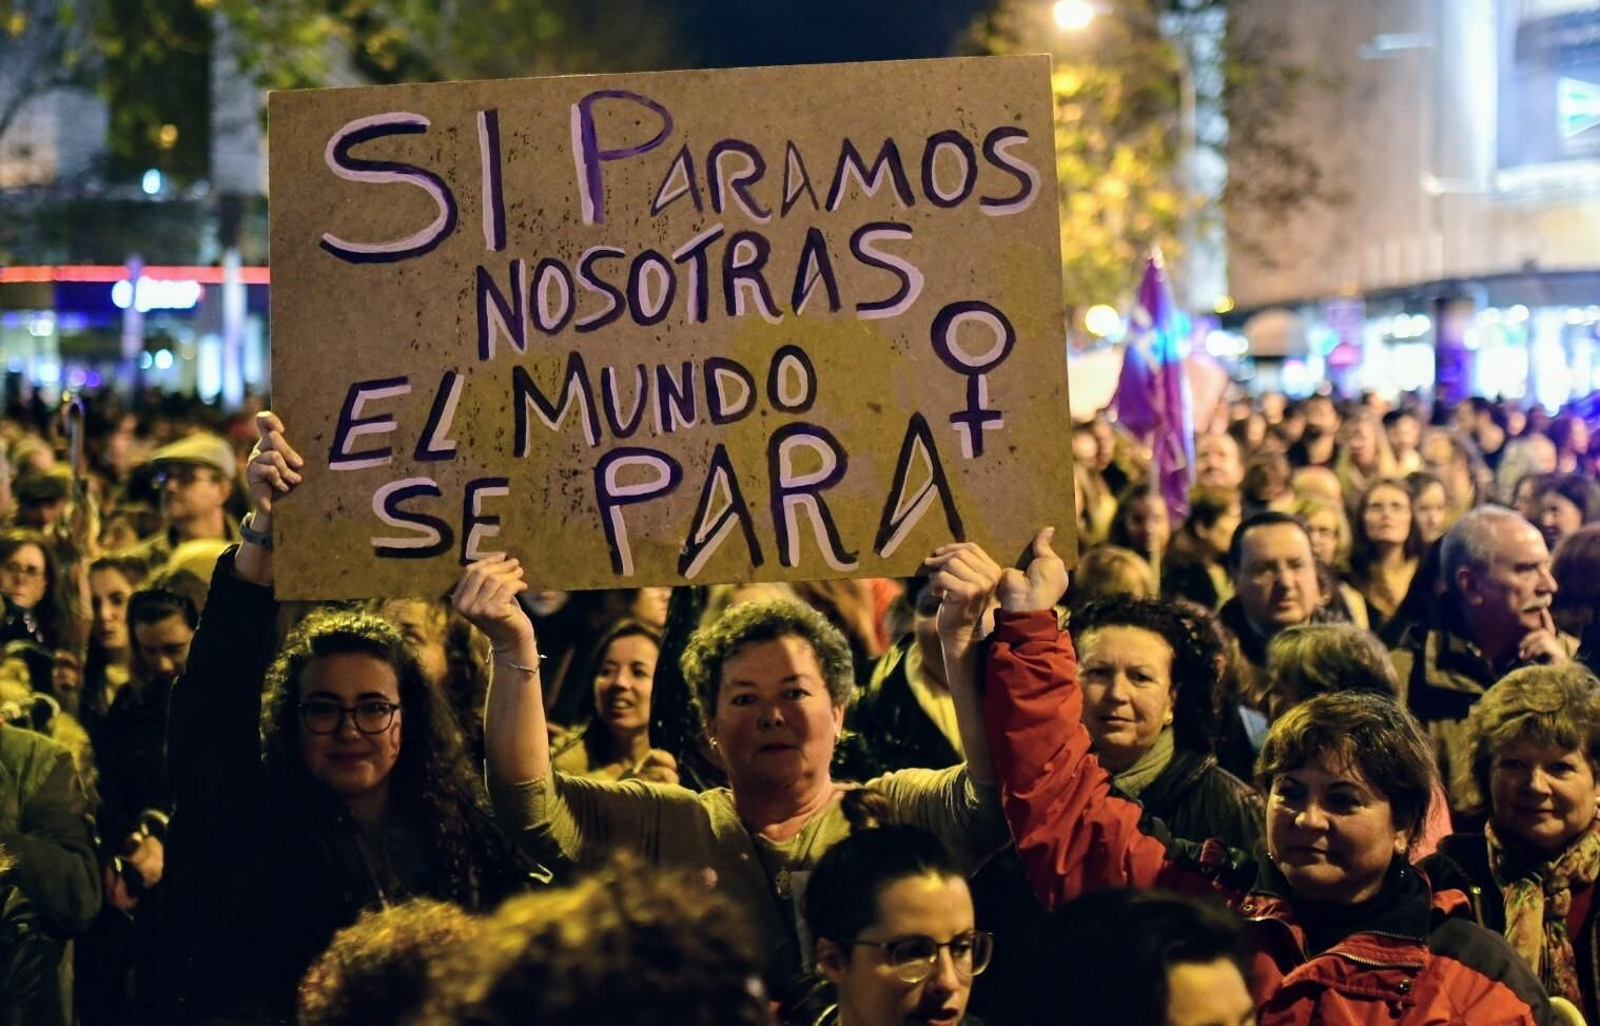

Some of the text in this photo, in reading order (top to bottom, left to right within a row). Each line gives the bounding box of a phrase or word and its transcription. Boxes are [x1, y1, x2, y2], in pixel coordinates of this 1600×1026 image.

[320, 89, 1042, 264] SI PARAMOS
[475, 222, 925, 361] NOSOTRAS
[328, 343, 817, 471] EL MUNDO
[370, 412, 965, 579] SE PARA
